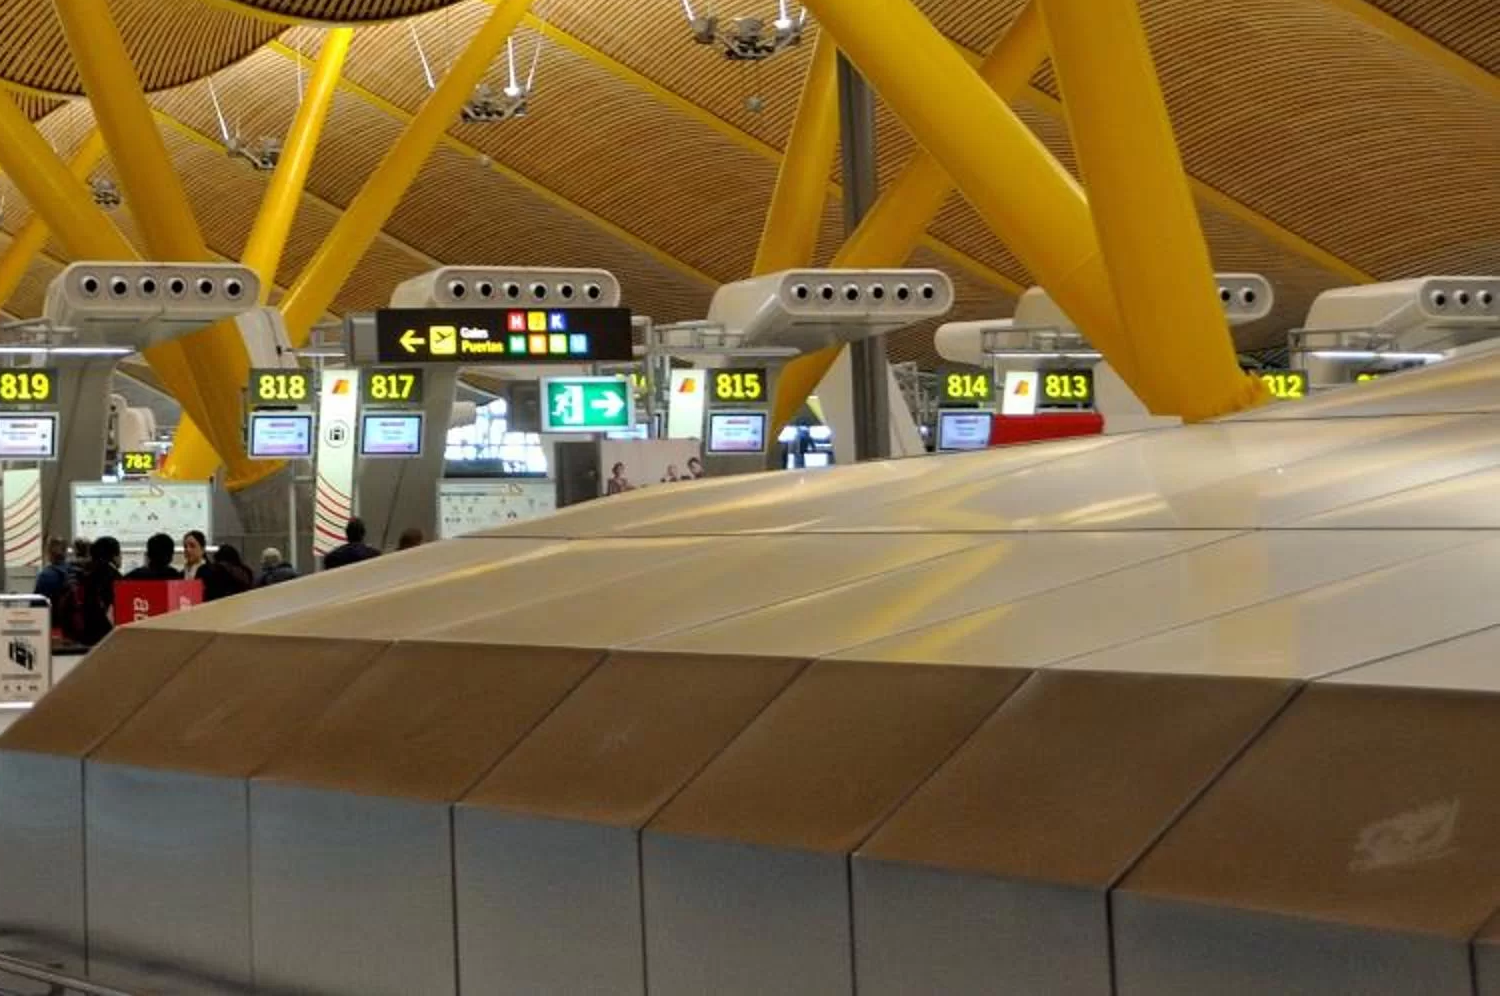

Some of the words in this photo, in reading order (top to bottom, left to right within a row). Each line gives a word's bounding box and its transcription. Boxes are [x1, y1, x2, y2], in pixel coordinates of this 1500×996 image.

[551, 313, 564, 329] K
[461, 339, 504, 354] Puertas
[0, 373, 50, 400] 819
[259, 375, 306, 400] 818
[371, 375, 415, 400] 817
[716, 373, 761, 399] 815
[947, 374, 989, 397] 814
[1046, 375, 1088, 398] 813
[124, 454, 153, 470] 782
